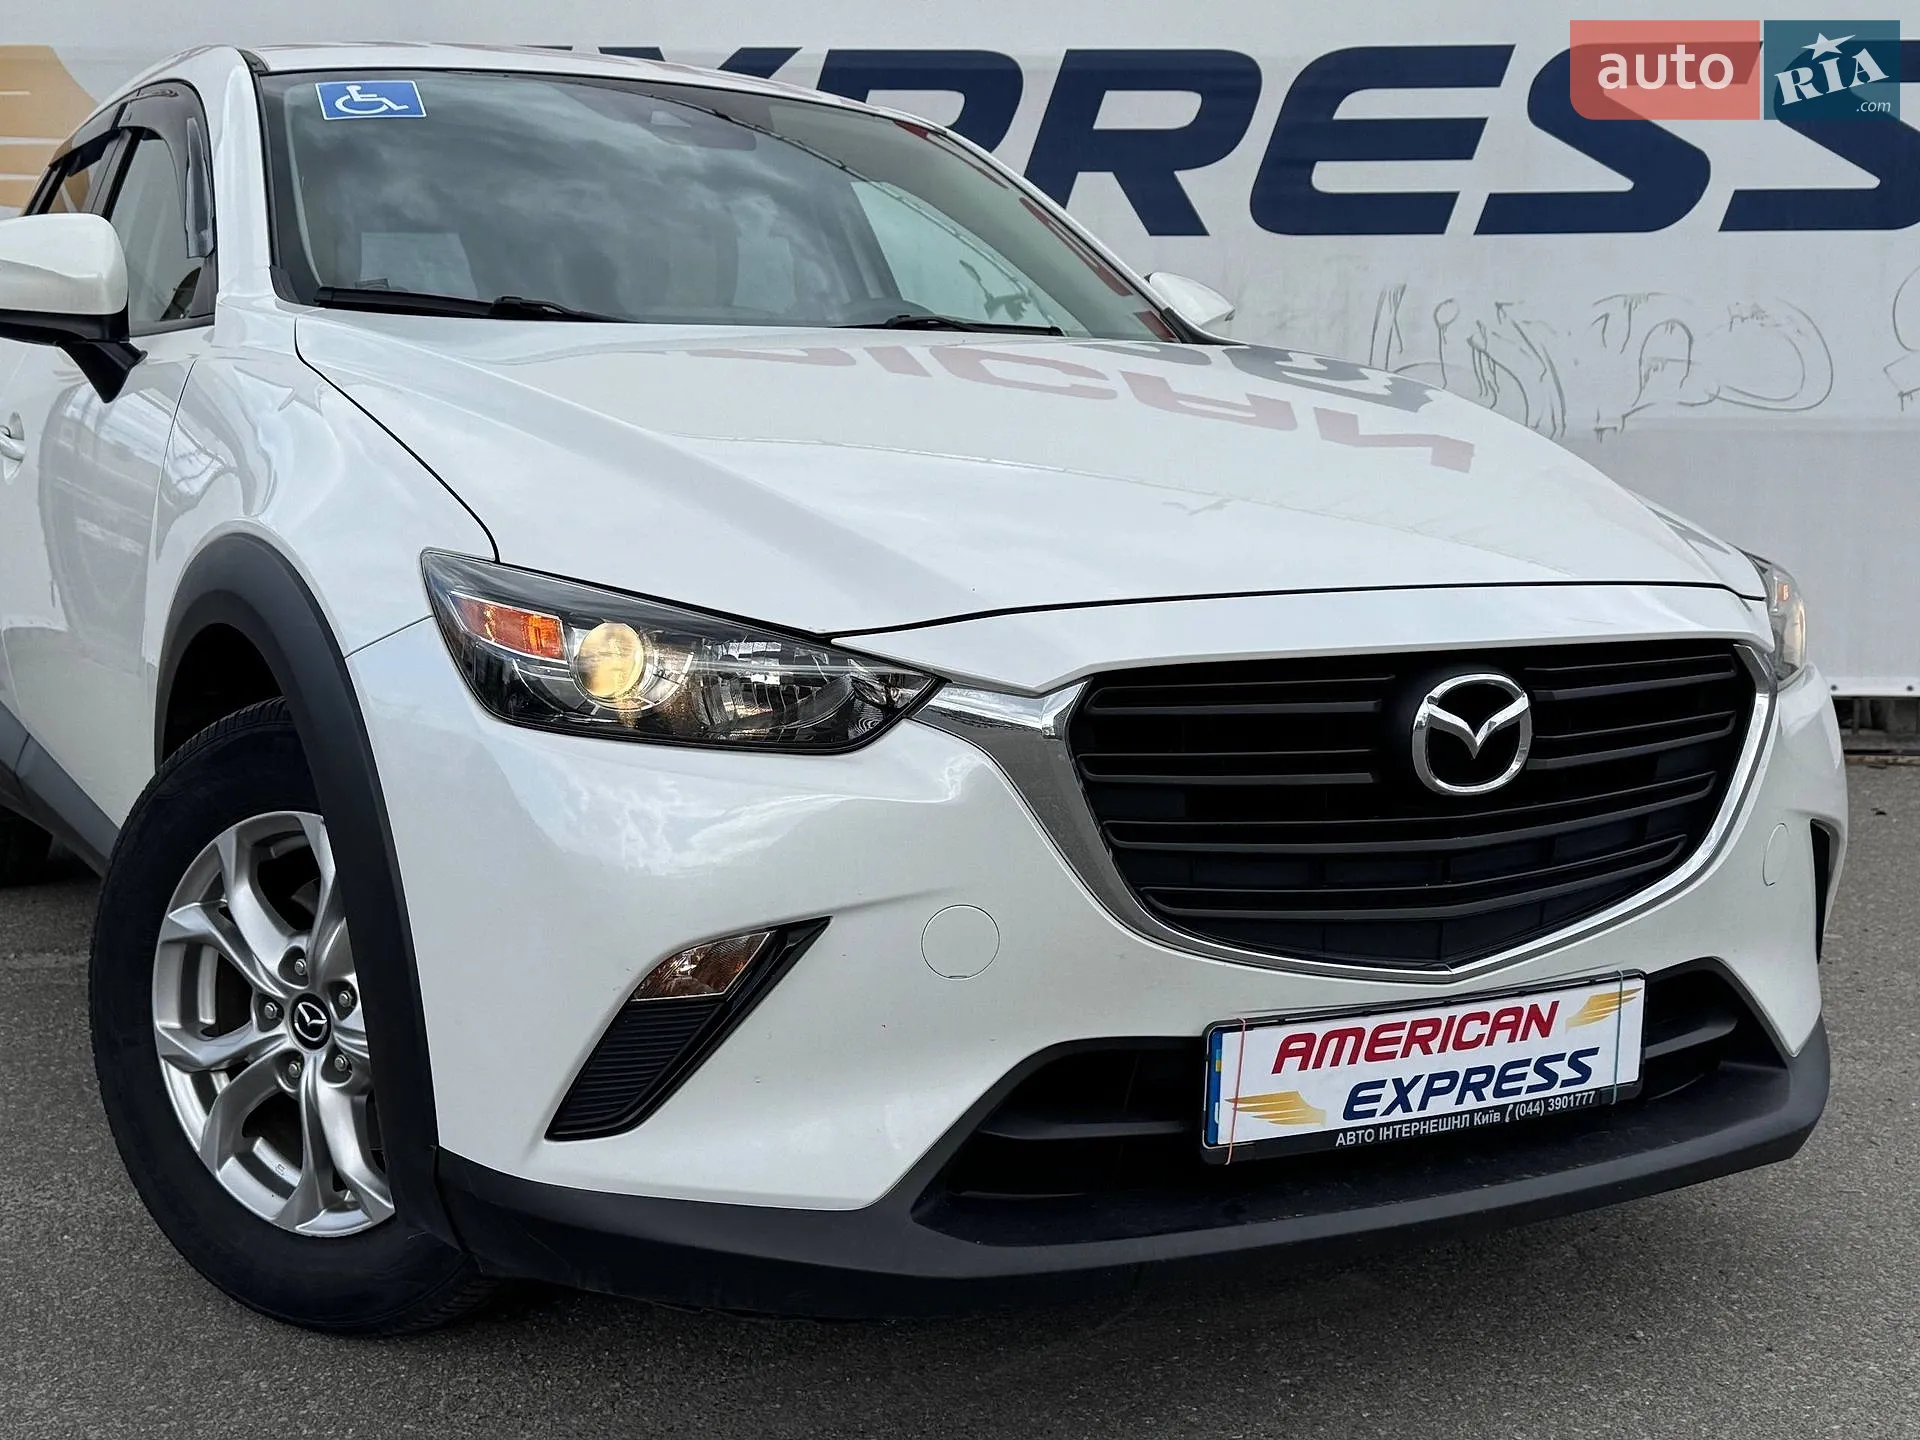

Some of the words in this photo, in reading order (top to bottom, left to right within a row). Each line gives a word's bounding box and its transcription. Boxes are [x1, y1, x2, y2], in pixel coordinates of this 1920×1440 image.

[1271, 1000, 1560, 1075] AMERICAN
[1335, 1128, 1376, 1148] АВТО
[1379, 1113, 1470, 1141] ІНТЕРНЕШНЛ
[1473, 1107, 1501, 1127] Київ
[1515, 1099, 1545, 1120] (044)
[1547, 1090, 1596, 1112] 3901777
[1343, 1046, 1600, 1121] EXPRESS
